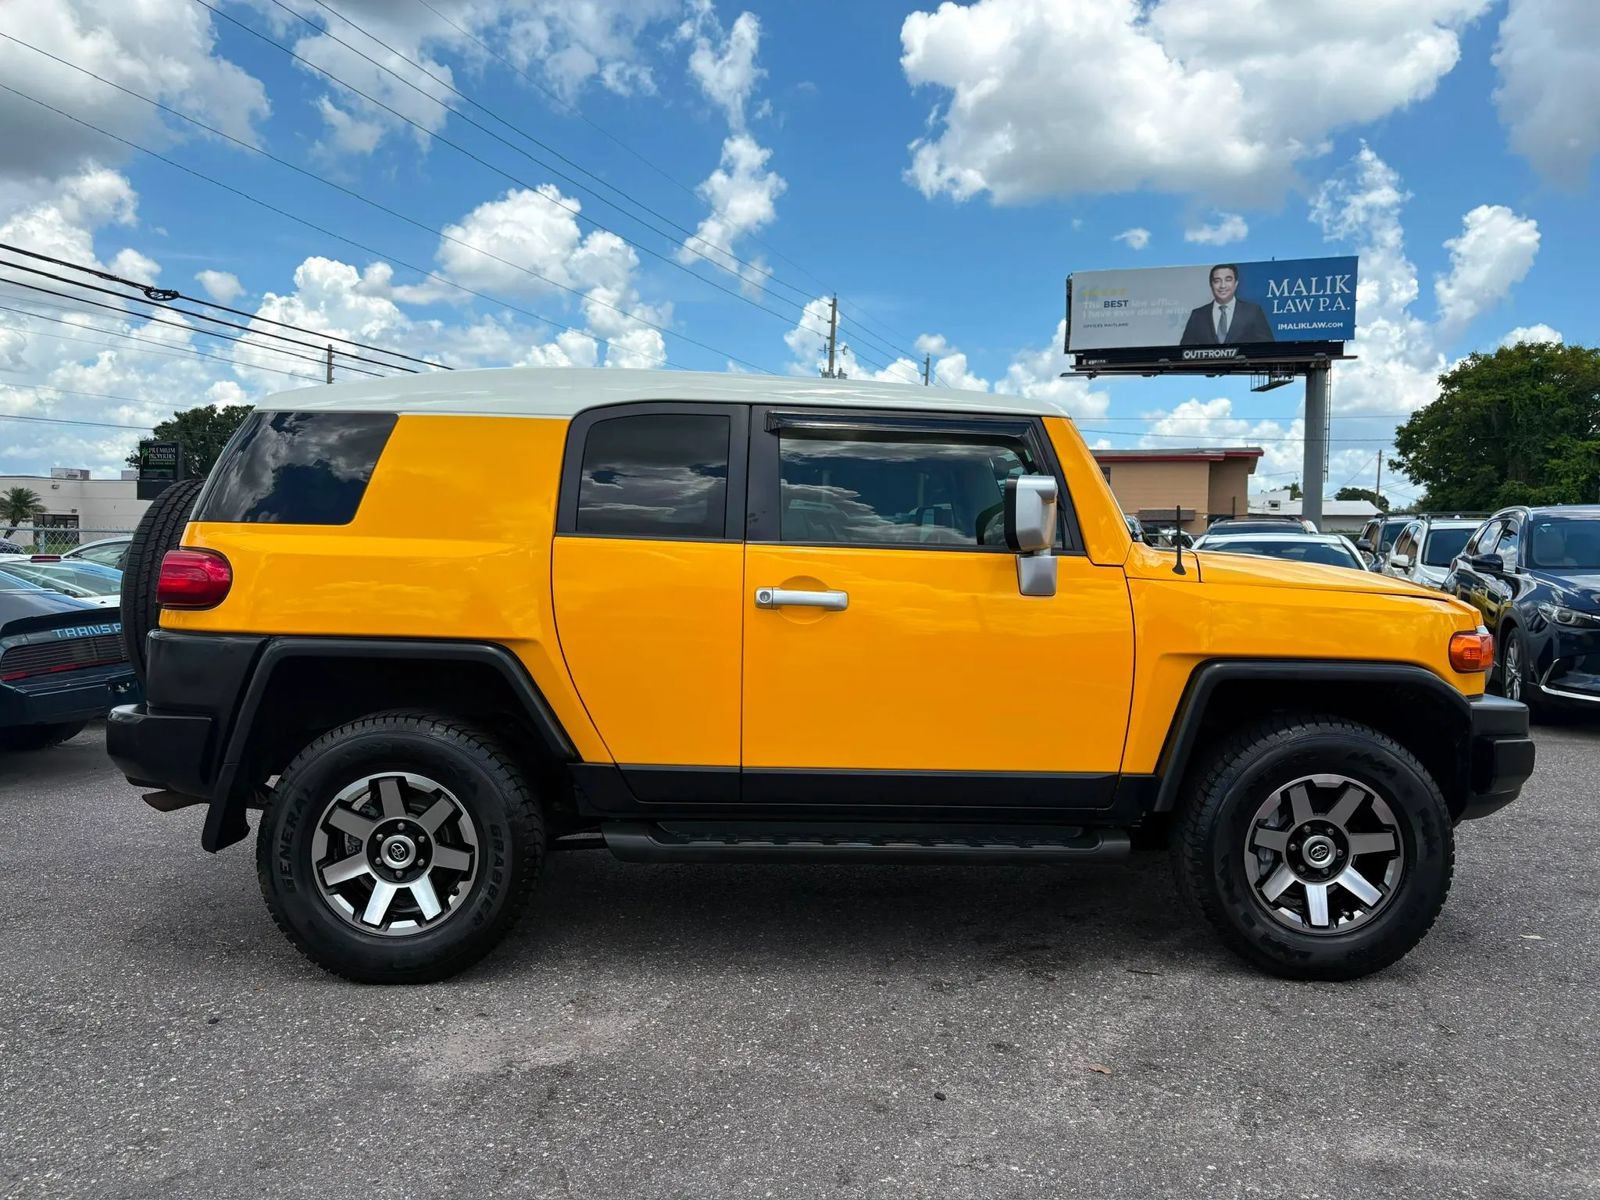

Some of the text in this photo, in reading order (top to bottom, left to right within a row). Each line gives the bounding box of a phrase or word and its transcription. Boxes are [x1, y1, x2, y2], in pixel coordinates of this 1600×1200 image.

[1266, 274, 1352, 297] MALIK
[1103, 299, 1129, 308] BEST
[1272, 297, 1351, 314] LAW P.A.
[1278, 322, 1343, 330] IMALIKLAW.COM
[51, 624, 112, 638] TRANS
[471, 823, 505, 927] GRABBER
